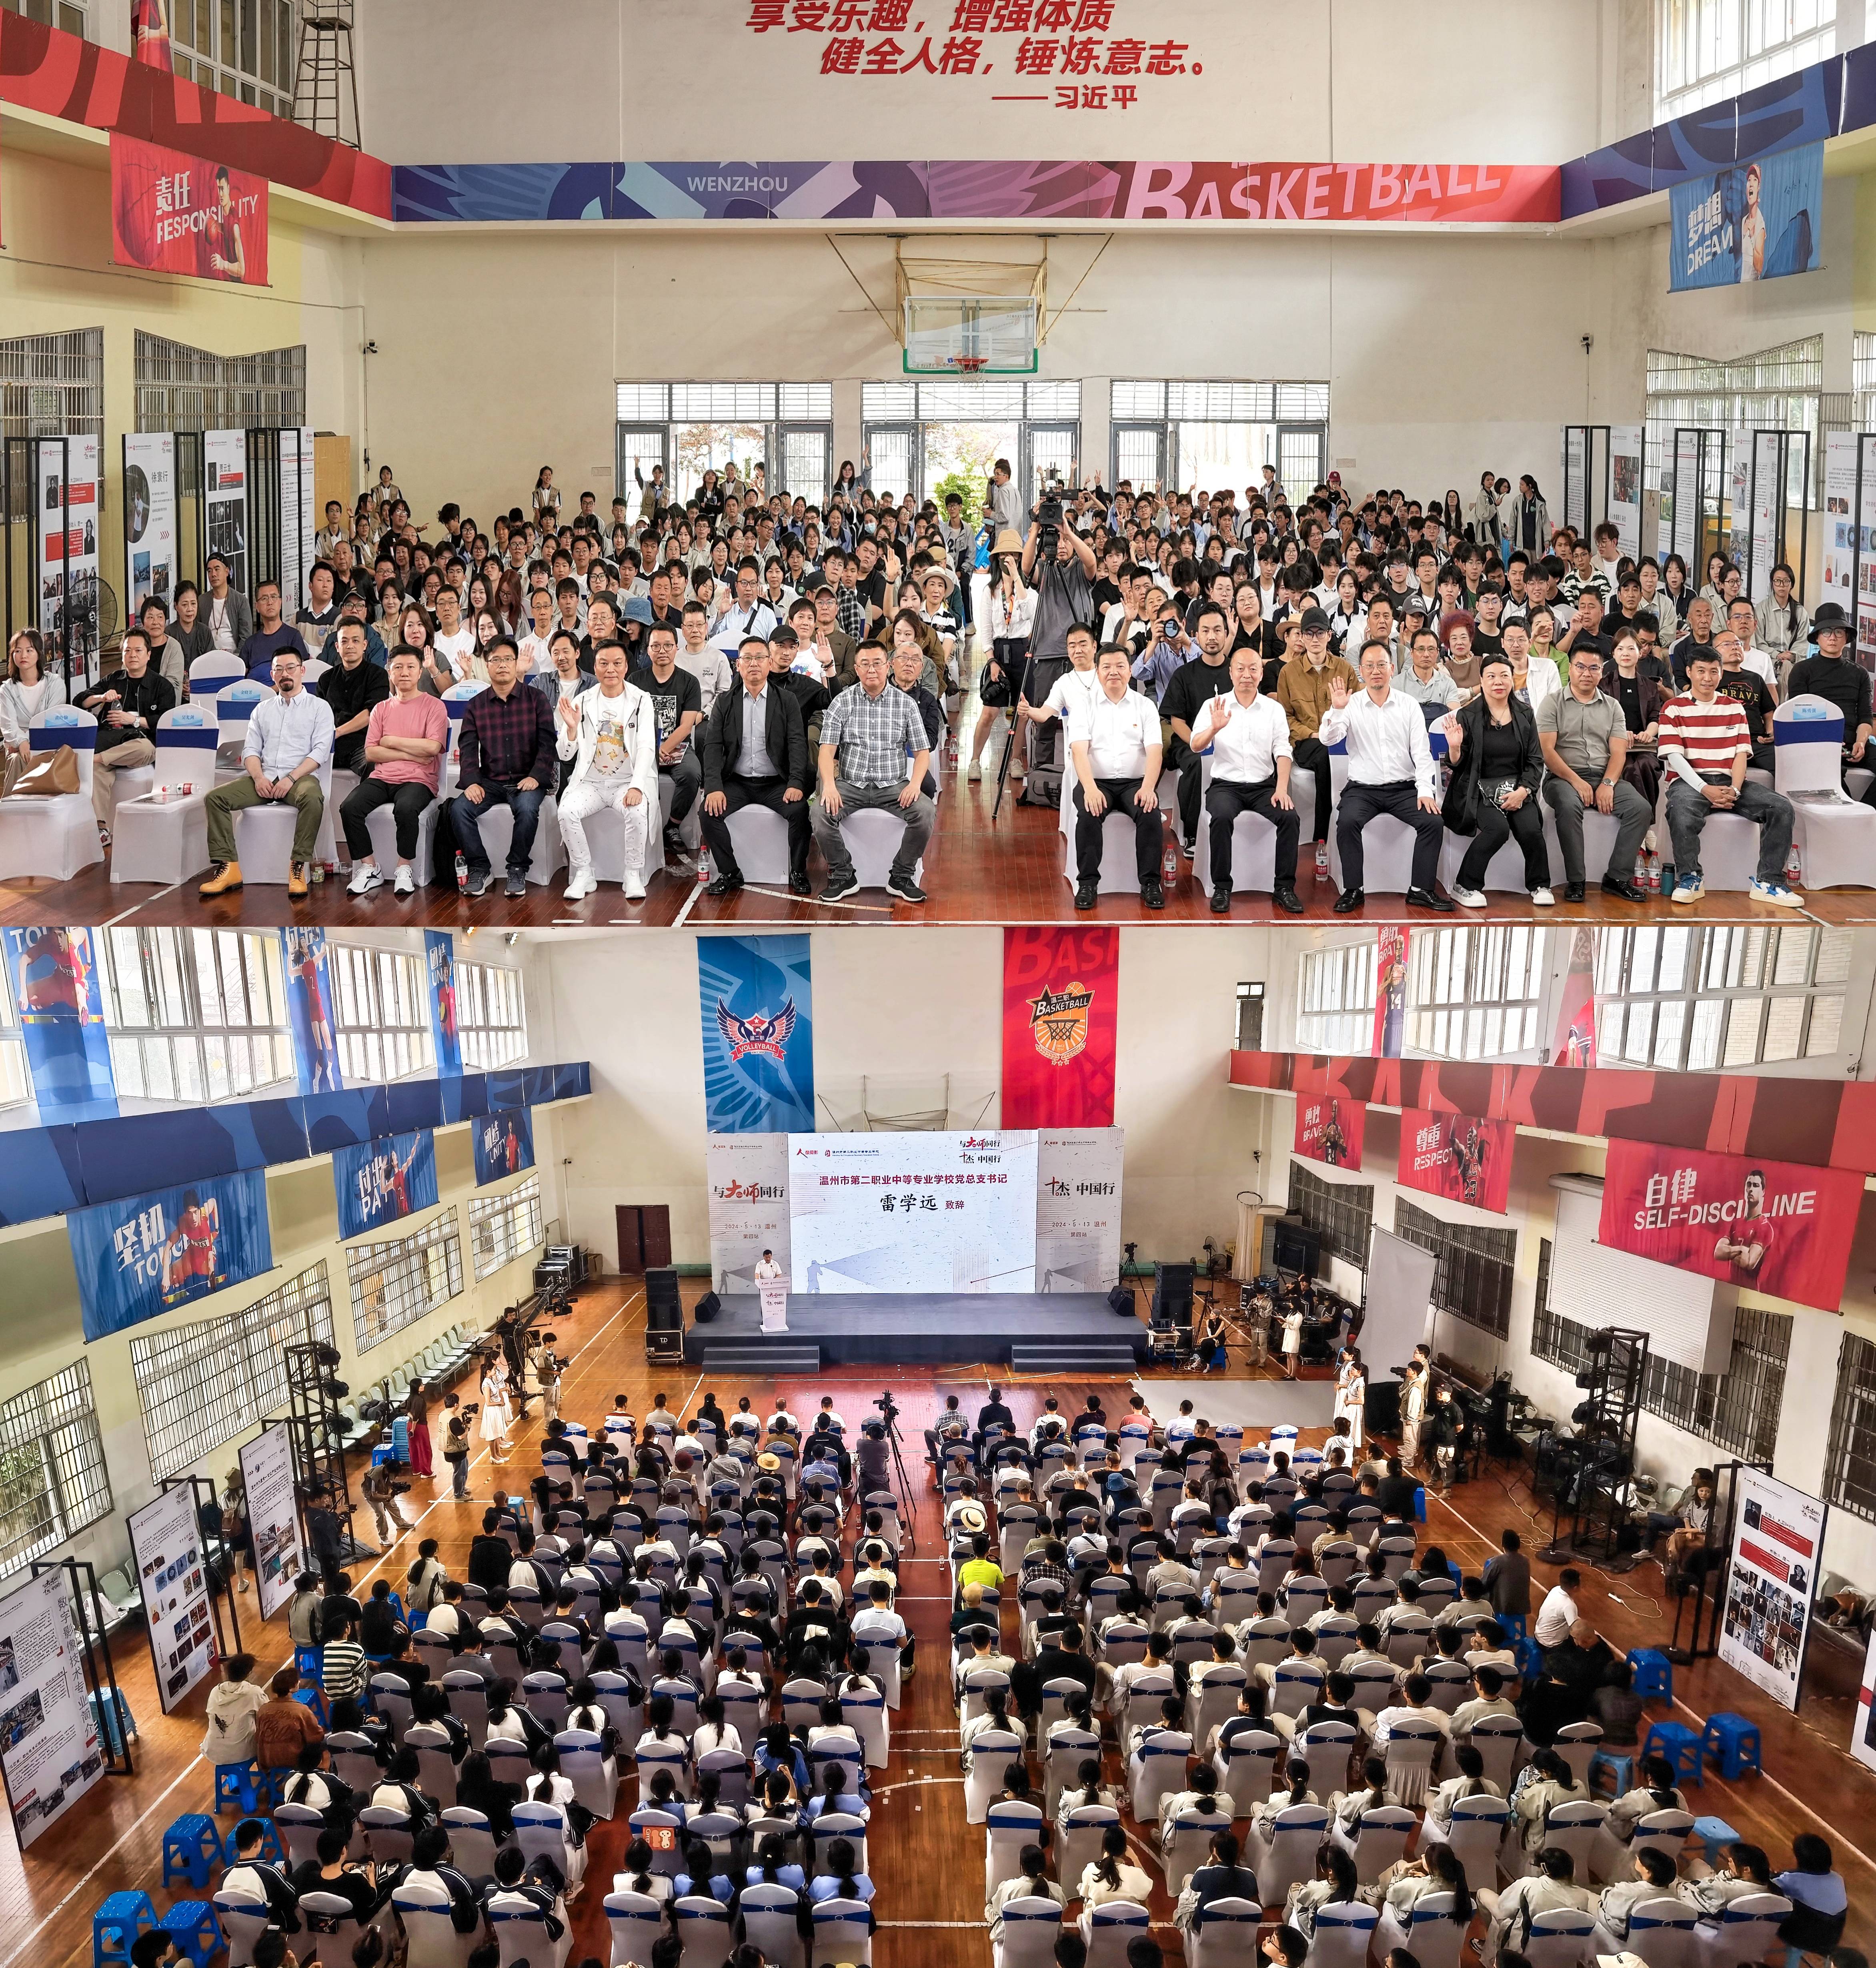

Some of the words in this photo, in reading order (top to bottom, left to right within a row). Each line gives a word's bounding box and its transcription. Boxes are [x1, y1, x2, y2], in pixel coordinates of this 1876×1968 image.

[745, 0, 1110, 33] 享受乐趣，增强体质
[818, 36, 1203, 75] 健全人格，锤炼意志。
[156, 170, 191, 216] 责任
[687, 176, 789, 192] WENZHOU
[1124, 162, 1502, 219] BASKETBALL
[1687, 225, 1733, 276] DREAM
[1722, 688, 1759, 701] BRAVE
[1035, 997, 1088, 1016] BASKETBALL
[739, 1042, 776, 1052] VOLLEYBALL
[959, 1136, 1001, 1151] 与大师同行
[1416, 1123, 1441, 1152] 尊重
[489, 1136, 507, 1163] UNITY
[959, 1151, 975, 1164] 十杰
[977, 1155, 1001, 1164] 中国行
[819, 1173, 1007, 1185] 温州市第二职业中等专业学校党总支书记
[1044, 1176, 1070, 1196] 十杰
[1076, 1182, 1115, 1195] 中国行
[1464, 1179, 1477, 1199] 23
[1645, 1167, 1698, 1208] 自律
[715, 1179, 785, 1204] 与大师同行
[880, 1193, 938, 1212] 雷学远
[945, 1200, 965, 1210] 致辞
[113, 1203, 166, 1273] 坚韧
